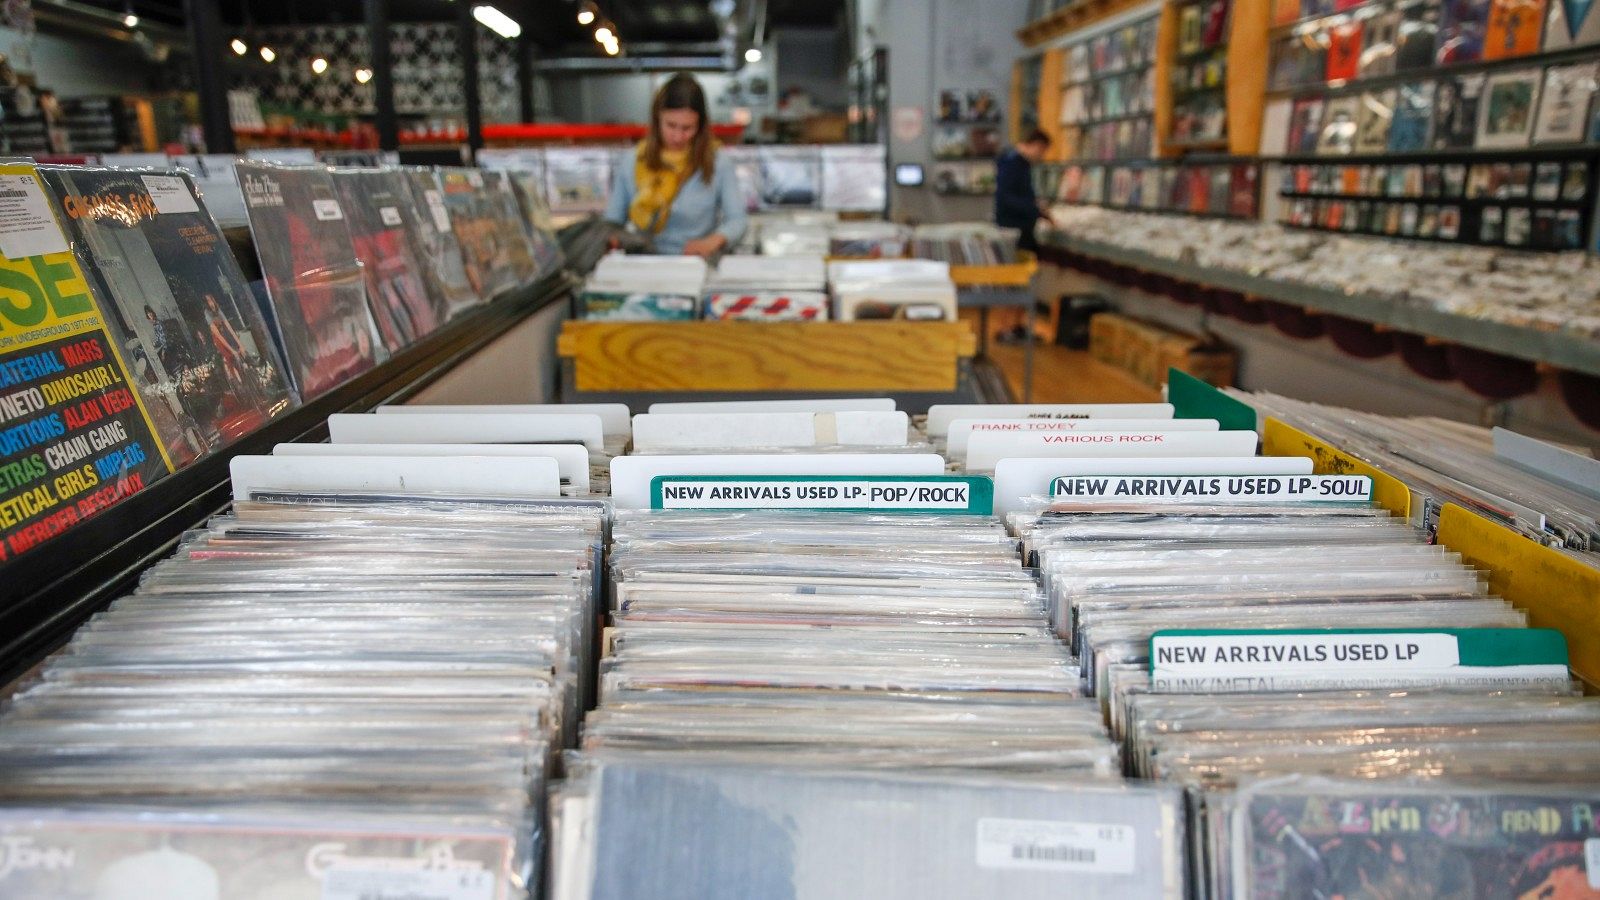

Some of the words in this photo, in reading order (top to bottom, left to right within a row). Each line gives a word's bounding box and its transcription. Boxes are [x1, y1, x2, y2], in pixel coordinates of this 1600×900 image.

[0, 351, 65, 388] ATERIAL
[60, 339, 104, 368] MARS
[40, 366, 113, 405] DINOSAUR
[108, 363, 121, 383] L
[64, 395, 103, 431] ALAN
[99, 387, 136, 416] VEGA
[971, 423, 1021, 431] FRANK
[1029, 422, 1077, 430] TOVEY
[1043, 435, 1114, 443] VARIOUS
[1119, 434, 1165, 442] ROCK
[45, 435, 92, 470] CHAIN
[89, 420, 128, 451] GANG
[0, 484, 58, 530] ETICAL
[54, 464, 98, 500] GIRLS
[664, 486, 704, 500] NEW
[709, 486, 792, 500] ARRIVALS
[796, 486, 839, 500] USED
[1056, 479, 1109, 496] NEW
[1114, 479, 1221, 496] ARRIVALS
[1227, 478, 1282, 495] USED
[1158, 646, 1206, 663] NEW
[1214, 645, 1328, 663] ARRIVALS
[1334, 644, 1389, 661] USED
[1395, 643, 1420, 660] LP
